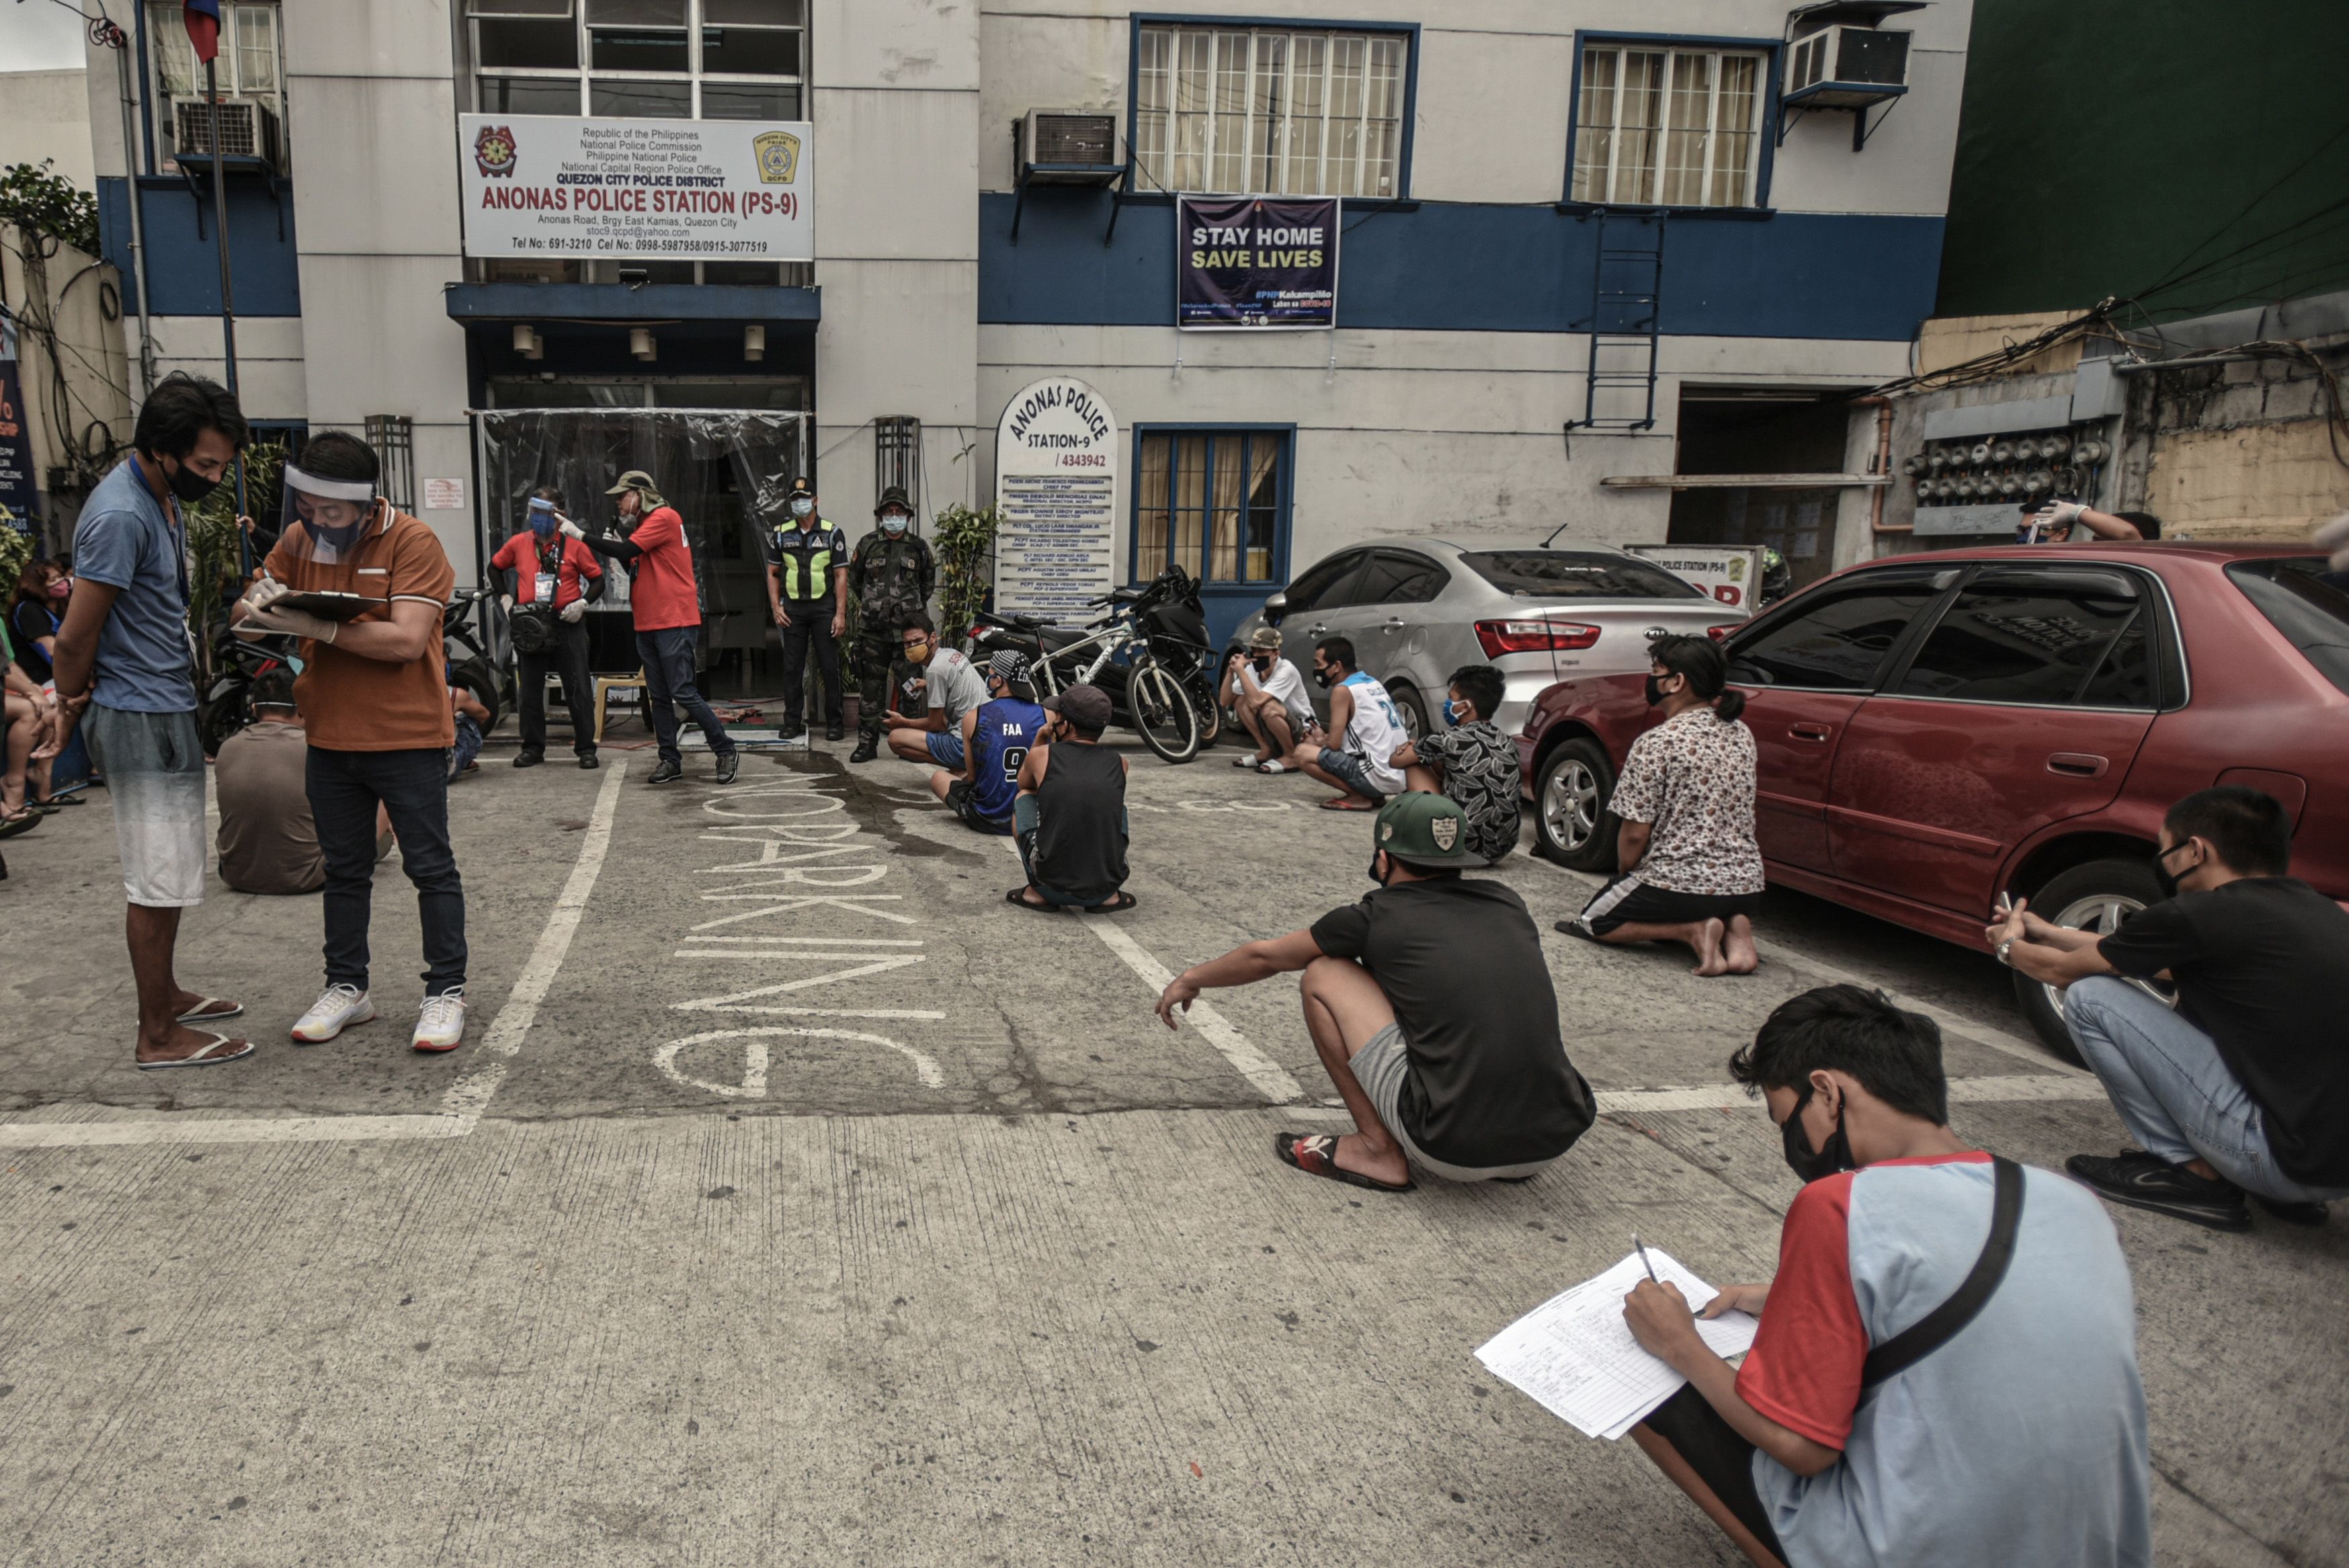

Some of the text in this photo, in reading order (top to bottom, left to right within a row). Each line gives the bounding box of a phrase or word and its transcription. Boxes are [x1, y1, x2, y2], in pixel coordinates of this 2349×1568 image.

[583, 128, 699, 140] Republic of the Philippines
[580, 140, 702, 151] National Police Commission
[586, 151, 697, 163] Philippine National Police
[773, 155, 781, 164] A
[562, 162, 722, 175] National Capital Region Police Office
[557, 173, 725, 188] QUEZON CITY POLICE DISTRICT
[481, 186, 798, 220] ANONAS POLICE STATION (PS-9)
[538, 214, 737, 229] Anonas Road, Brgy East Kamias, Quezon City
[586, 226, 690, 239] stoc9.qcpd@yahoo.com
[1192, 227, 1323, 246] STAY HOME
[512, 237, 768, 253] Tel No: 691-3210 Cel No: 0998-5987958/0915-3077519
[1191, 249, 1323, 269] SAVE LIVES
[1009, 384, 1109, 442] ANONAS POLICE
[1028, 434, 1090, 449] STATION-9
[1062, 454, 1106, 467] 4343942
[1662, 561, 1682, 571] POLICE
[1683, 561, 1707, 571] STATION
[1708, 561, 1726, 575] (PS-9)
[1003, 723, 1022, 736] FAA
[1003, 746, 1029, 783] 9
[651, 773, 946, 1098] NO PARKING
